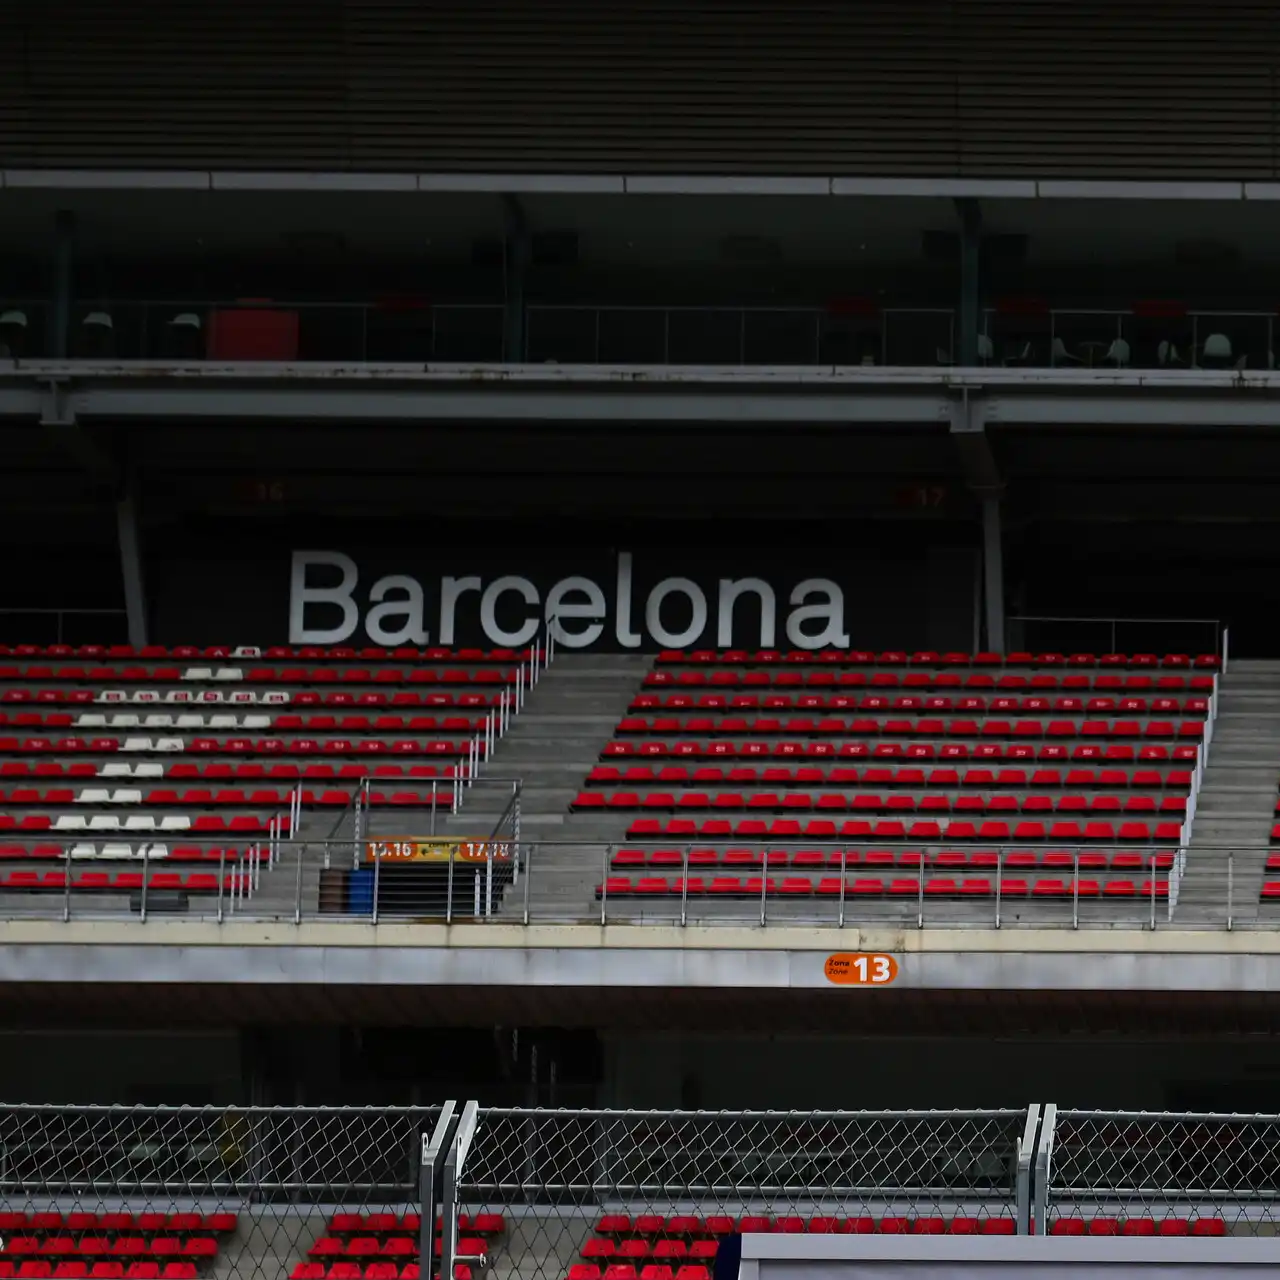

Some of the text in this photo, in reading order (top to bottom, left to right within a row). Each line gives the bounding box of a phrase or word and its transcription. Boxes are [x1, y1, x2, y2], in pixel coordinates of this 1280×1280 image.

[290, 550, 850, 649] Barcelona
[828, 959, 850, 967] Zona
[853, 957, 891, 982] 13
